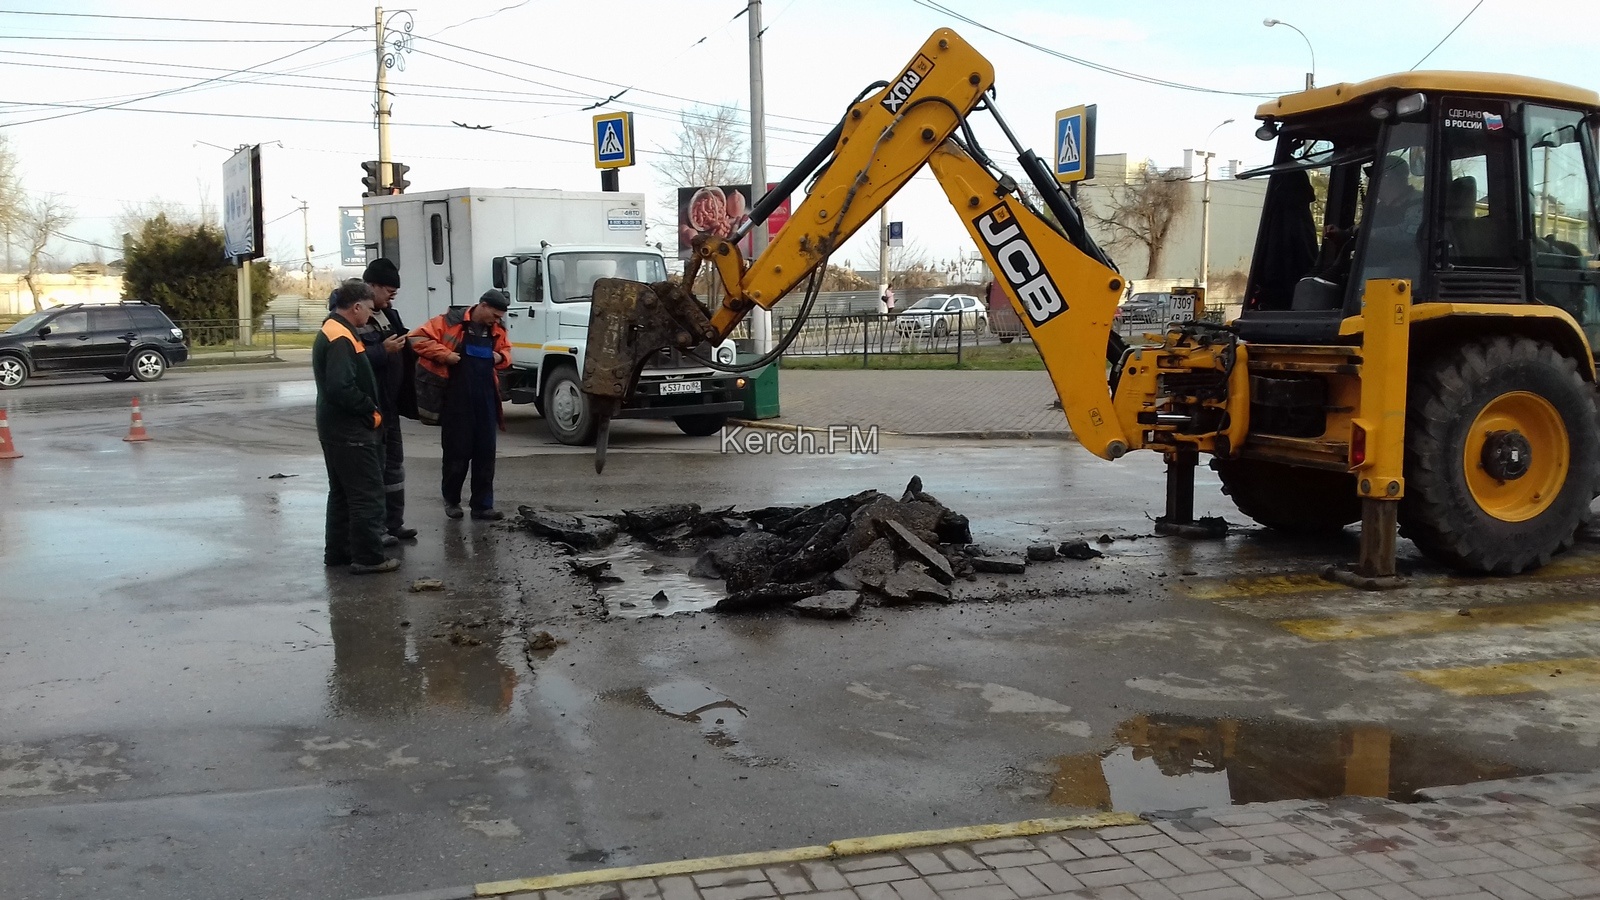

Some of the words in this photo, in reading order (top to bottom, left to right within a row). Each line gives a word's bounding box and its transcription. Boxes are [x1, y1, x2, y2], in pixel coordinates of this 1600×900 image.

[882, 70, 920, 113] 3CX
[1448, 108, 1482, 119] СДЕЛАНО
[1445, 119, 1451, 127] В
[1452, 120, 1483, 130] РОССИИ
[978, 214, 1062, 322] JCB
[1172, 297, 1192, 310] 7309
